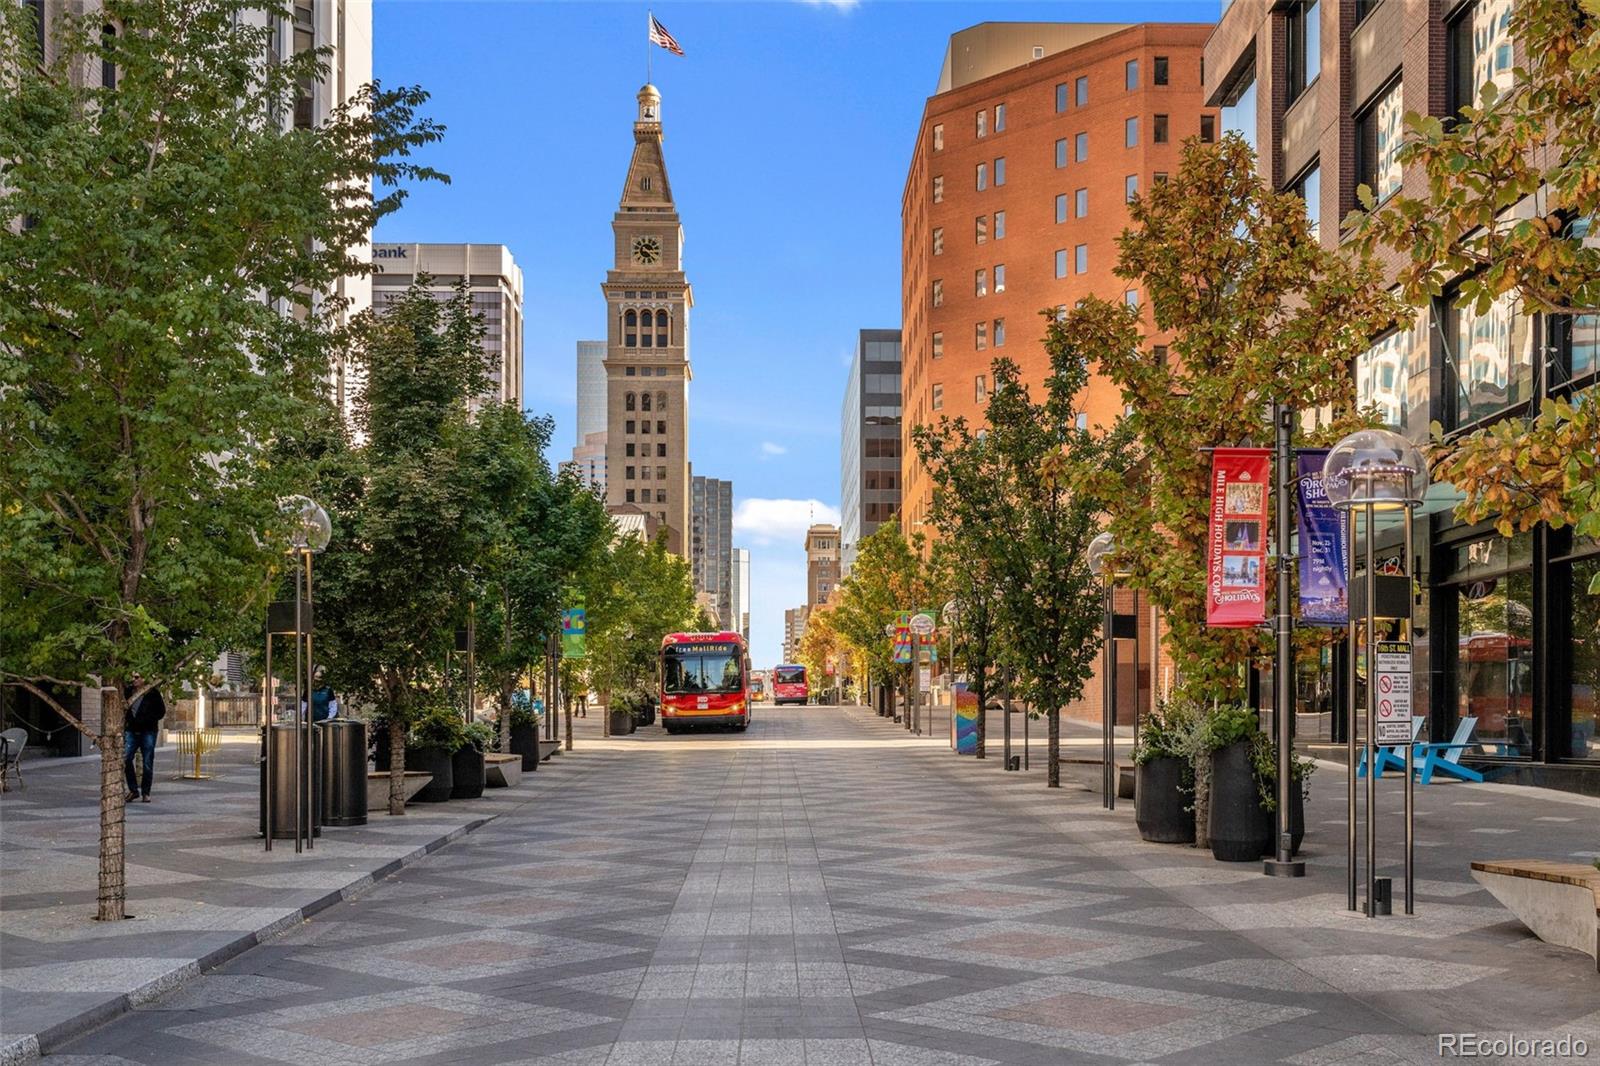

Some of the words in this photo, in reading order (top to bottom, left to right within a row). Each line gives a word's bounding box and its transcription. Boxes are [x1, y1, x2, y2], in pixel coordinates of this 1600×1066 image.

[1216, 470, 1226, 493] MILE
[1214, 496, 1224, 521] HIGH
[1212, 524, 1223, 596] HOLIDAYS.COM
